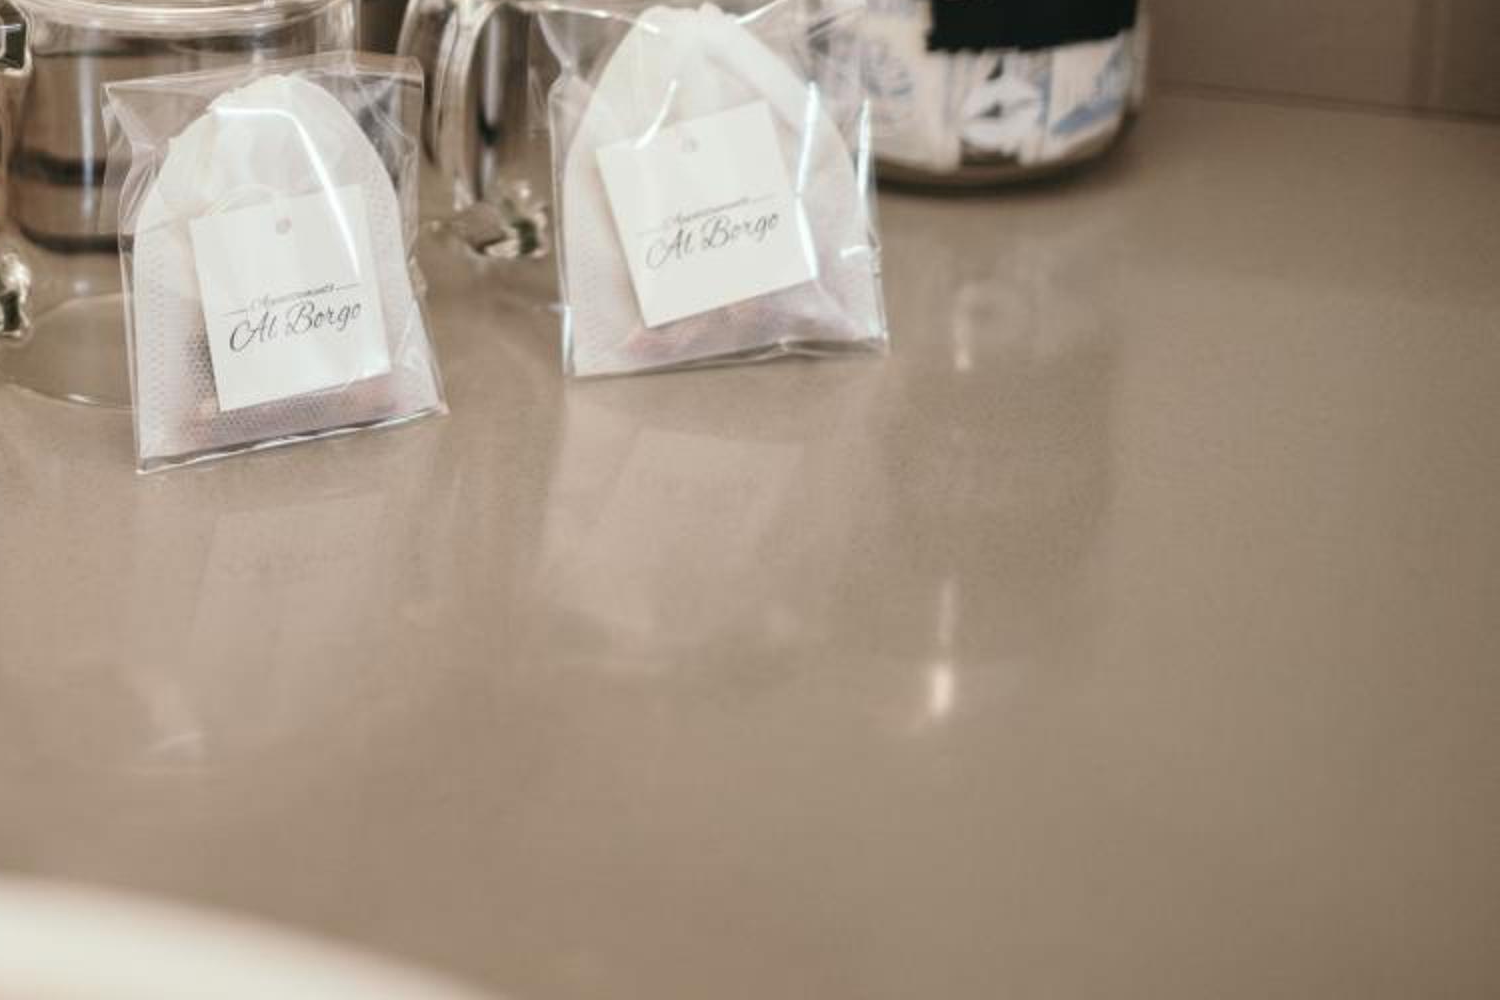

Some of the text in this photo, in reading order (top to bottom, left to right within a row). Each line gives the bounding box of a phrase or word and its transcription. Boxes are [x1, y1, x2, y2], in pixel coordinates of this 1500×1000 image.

[644, 212, 780, 269] Al Borgo
[229, 299, 362, 352] Al Borgo
